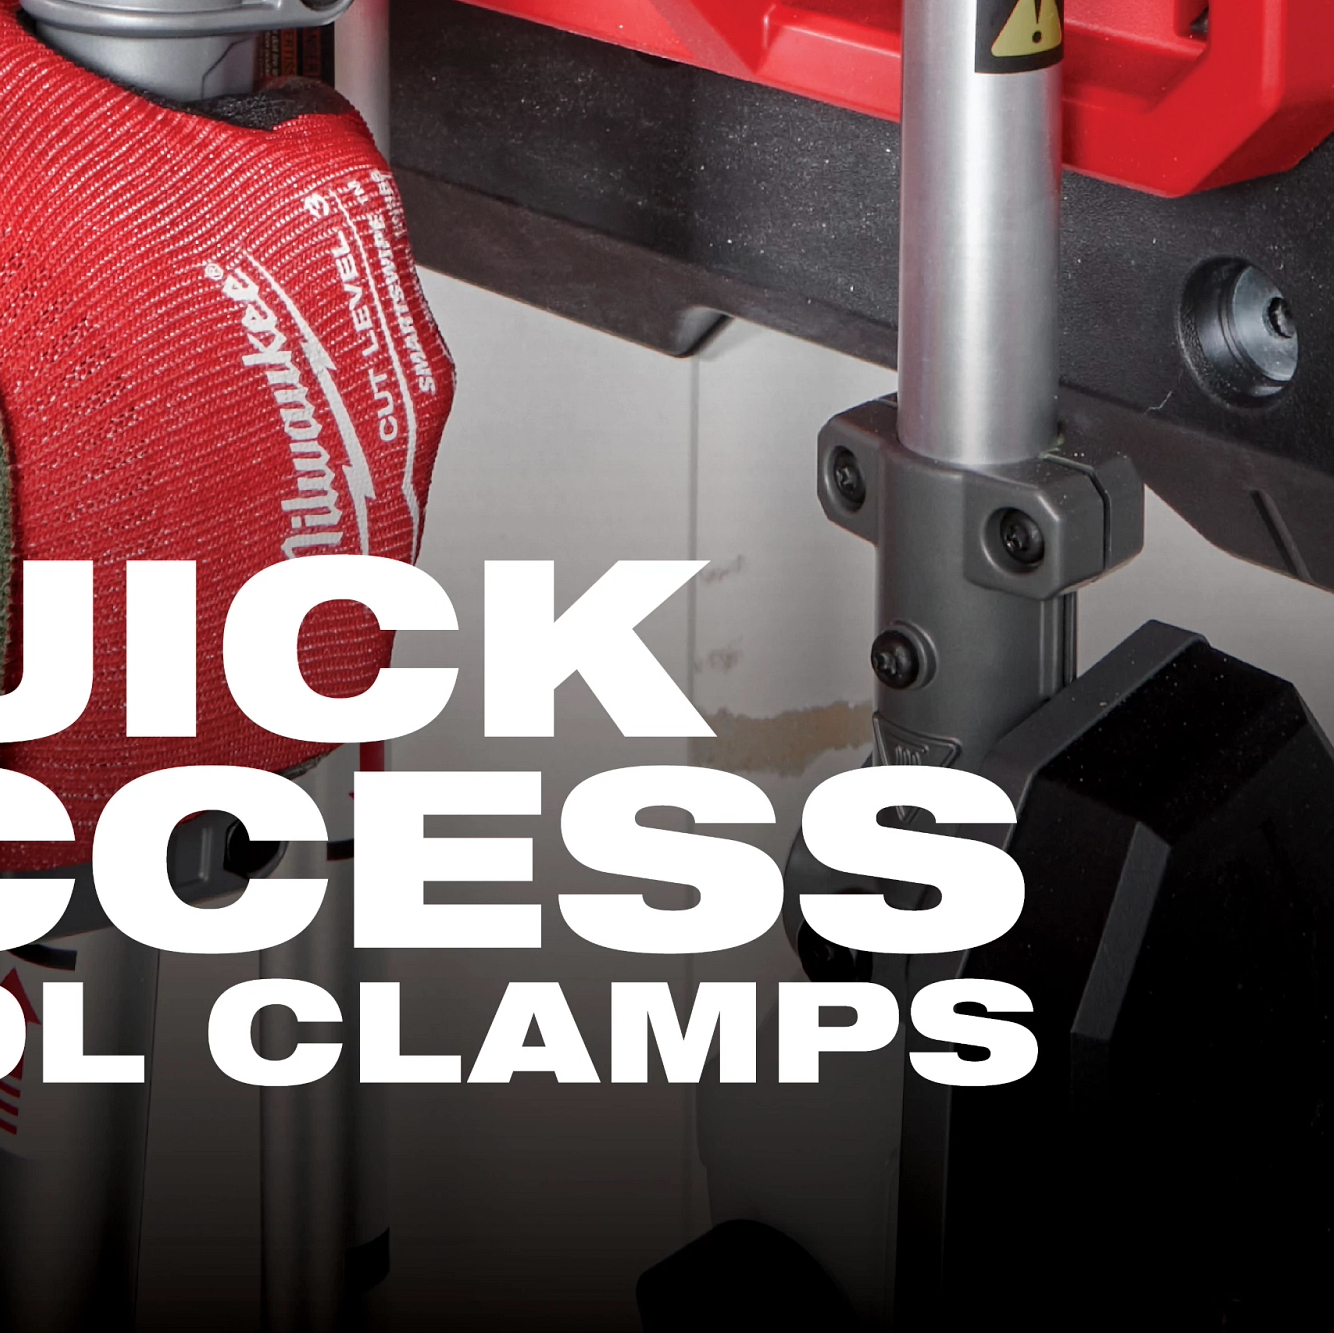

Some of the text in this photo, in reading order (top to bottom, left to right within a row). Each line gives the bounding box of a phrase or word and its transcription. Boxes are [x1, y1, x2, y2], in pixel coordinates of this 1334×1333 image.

[331, 228, 379, 357] LEVEL
[367, 212, 436, 394] SMARTSWIPE
[368, 368, 398, 442] CUT
